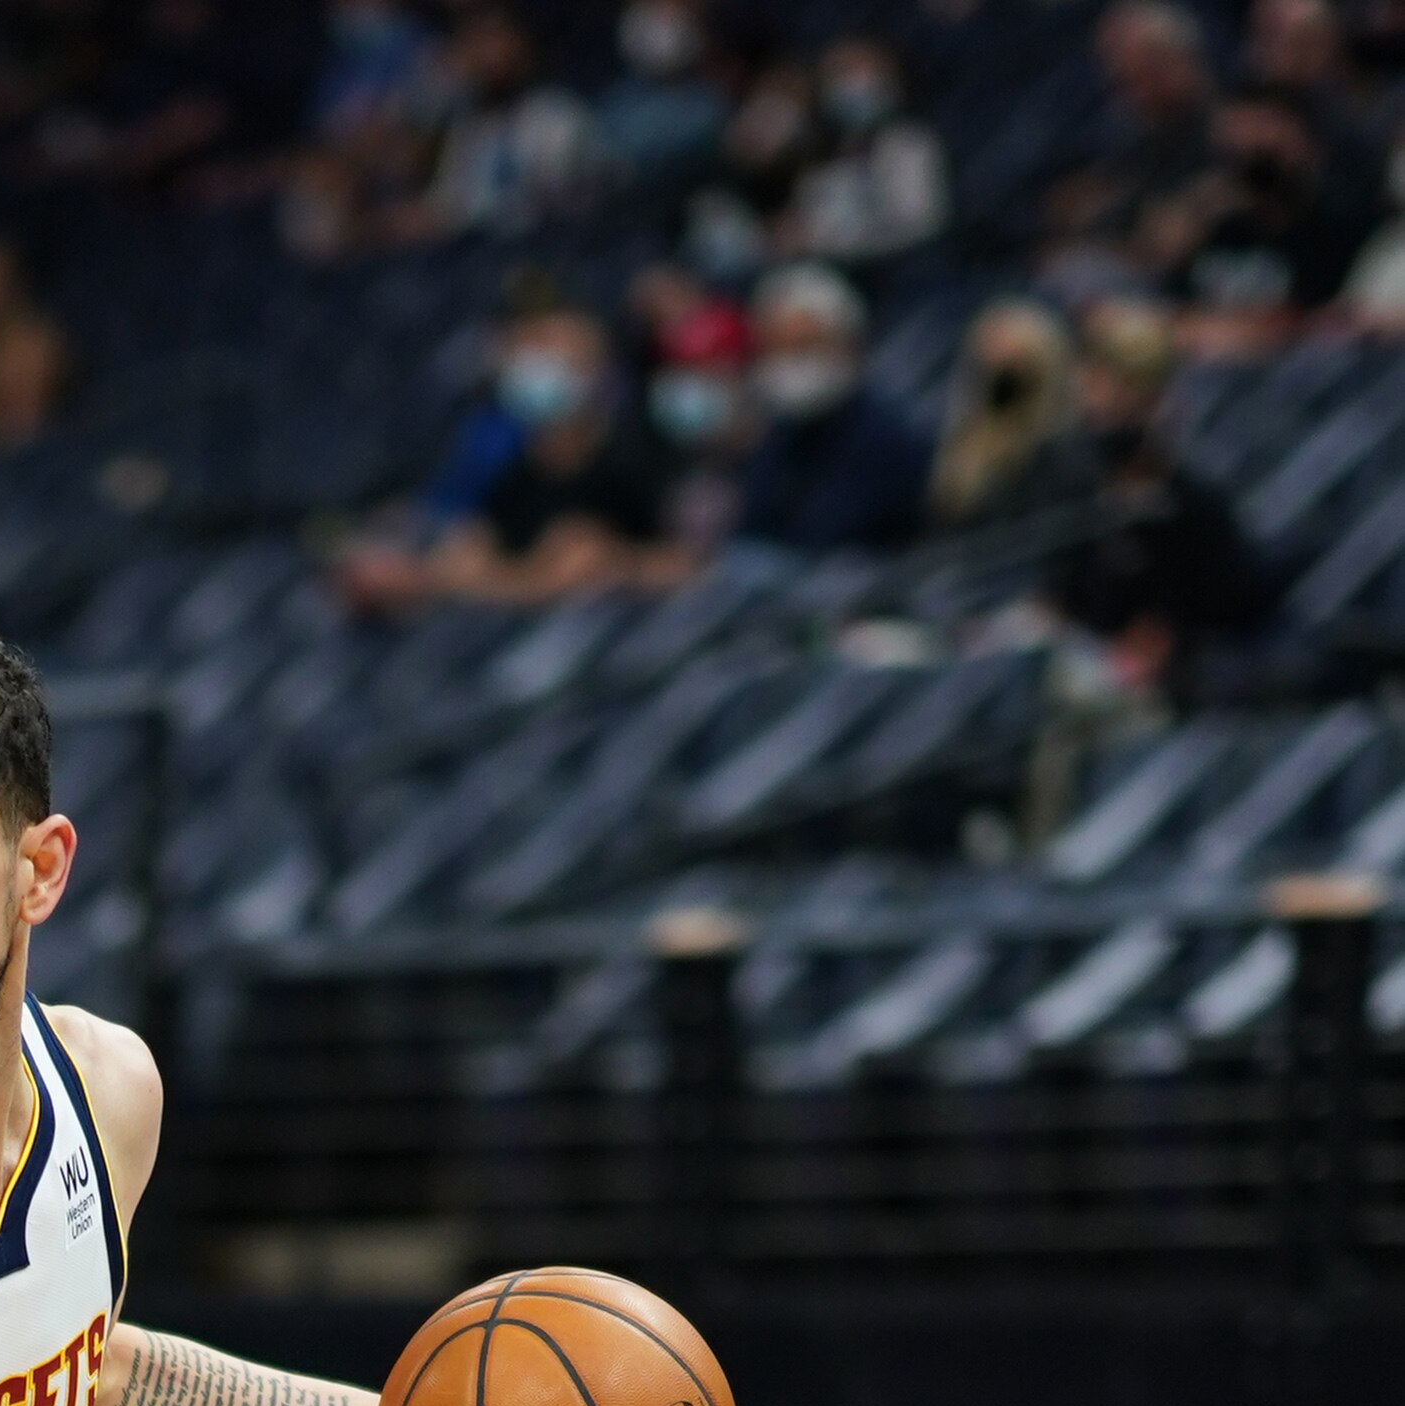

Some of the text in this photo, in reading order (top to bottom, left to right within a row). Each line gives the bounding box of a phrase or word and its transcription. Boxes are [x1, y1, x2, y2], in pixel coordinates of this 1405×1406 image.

[59, 1145, 89, 1200] WU
[66, 1193, 96, 1225] Western
[72, 1215, 93, 1240] Union
